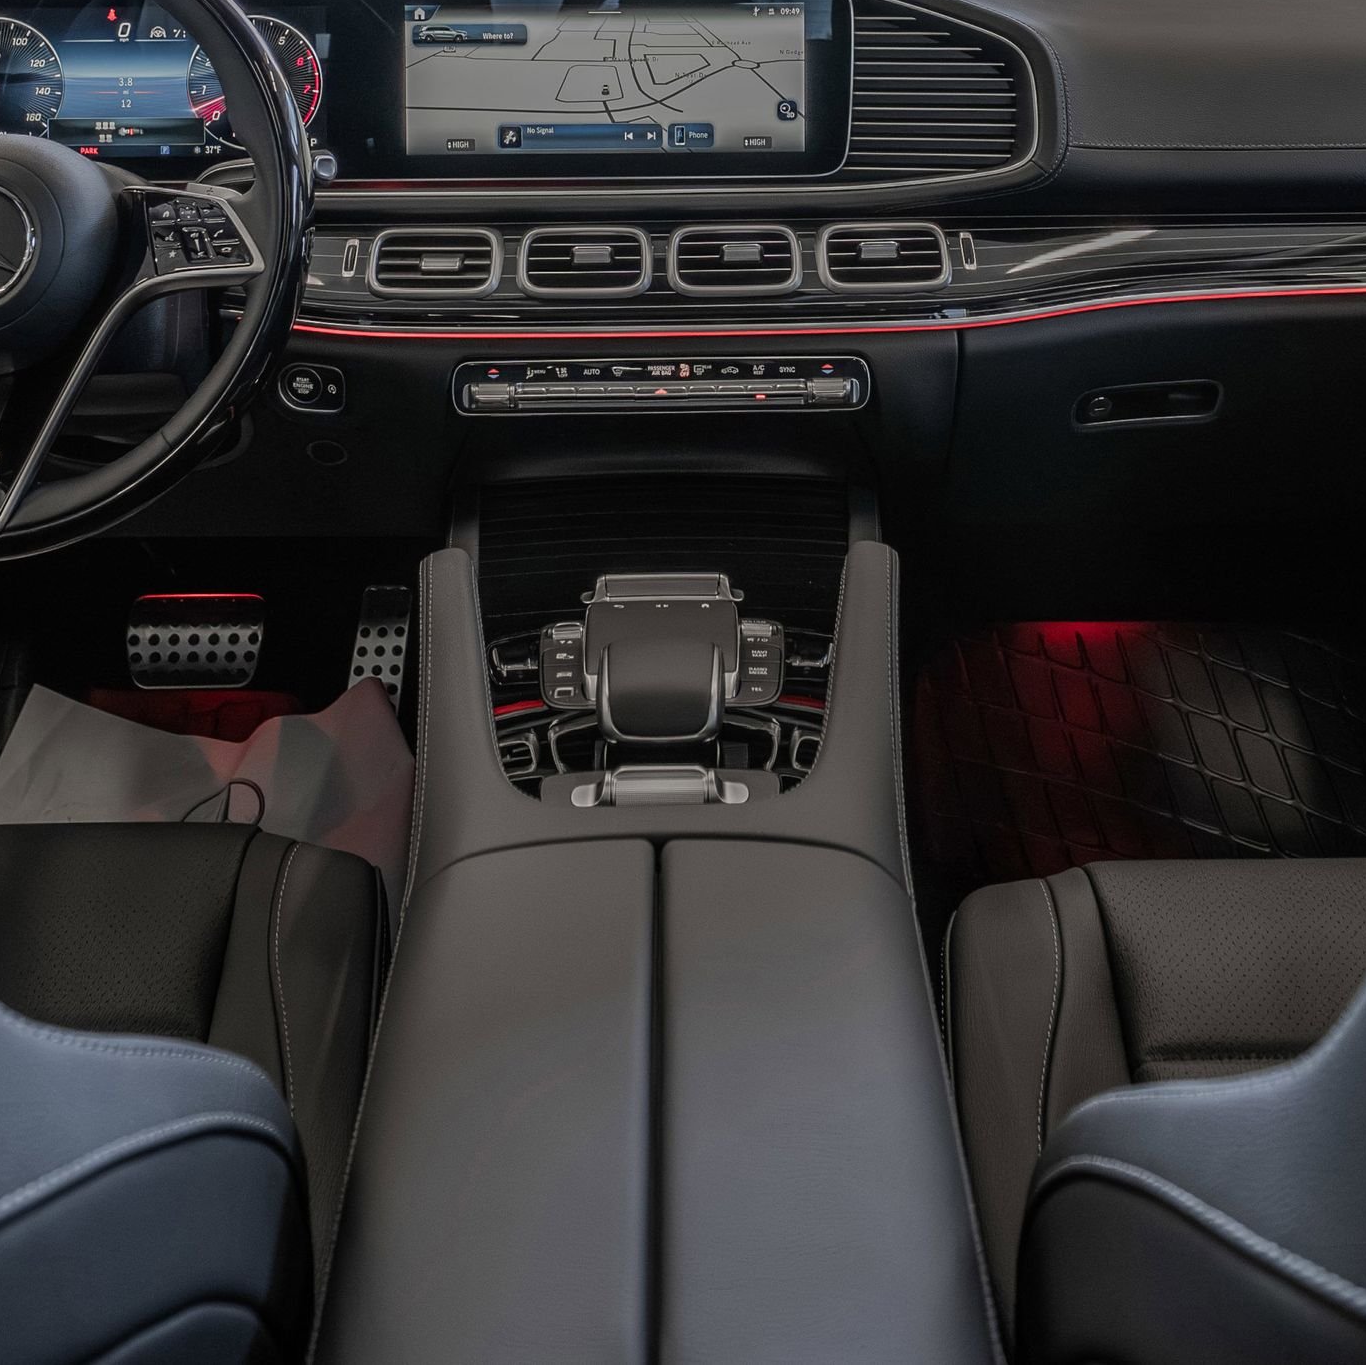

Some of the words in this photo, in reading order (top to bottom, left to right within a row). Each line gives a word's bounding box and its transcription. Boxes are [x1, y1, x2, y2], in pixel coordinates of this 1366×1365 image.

[780, 7, 800, 16] 09:49
[117, 22, 131, 37] 0
[482, 32, 502, 40] Where
[503, 32, 514, 40] to?
[12, 38, 27, 46] 100
[278, 36, 286, 46] 5
[30, 59, 45, 67] 120
[296, 57, 304, 67] 6
[118, 77, 133, 87] 3.8
[35, 87, 51, 95] 140
[202, 85, 207, 95] 1
[303, 85, 311, 94] 7
[120, 100, 131, 108] 12
[26, 113, 41, 122] 160
[212, 110, 221, 121] 0
[536, 127, 554, 135] Signal
[688, 131, 708, 139] Phone
[310, 138, 317, 147] P
[452, 141, 469, 149] HIGH
[749, 139, 766, 147] HIGH
[204, 145, 222, 154] 37°F
[583, 368, 601, 376] AUTO
[778, 366, 796, 374] SYNC
